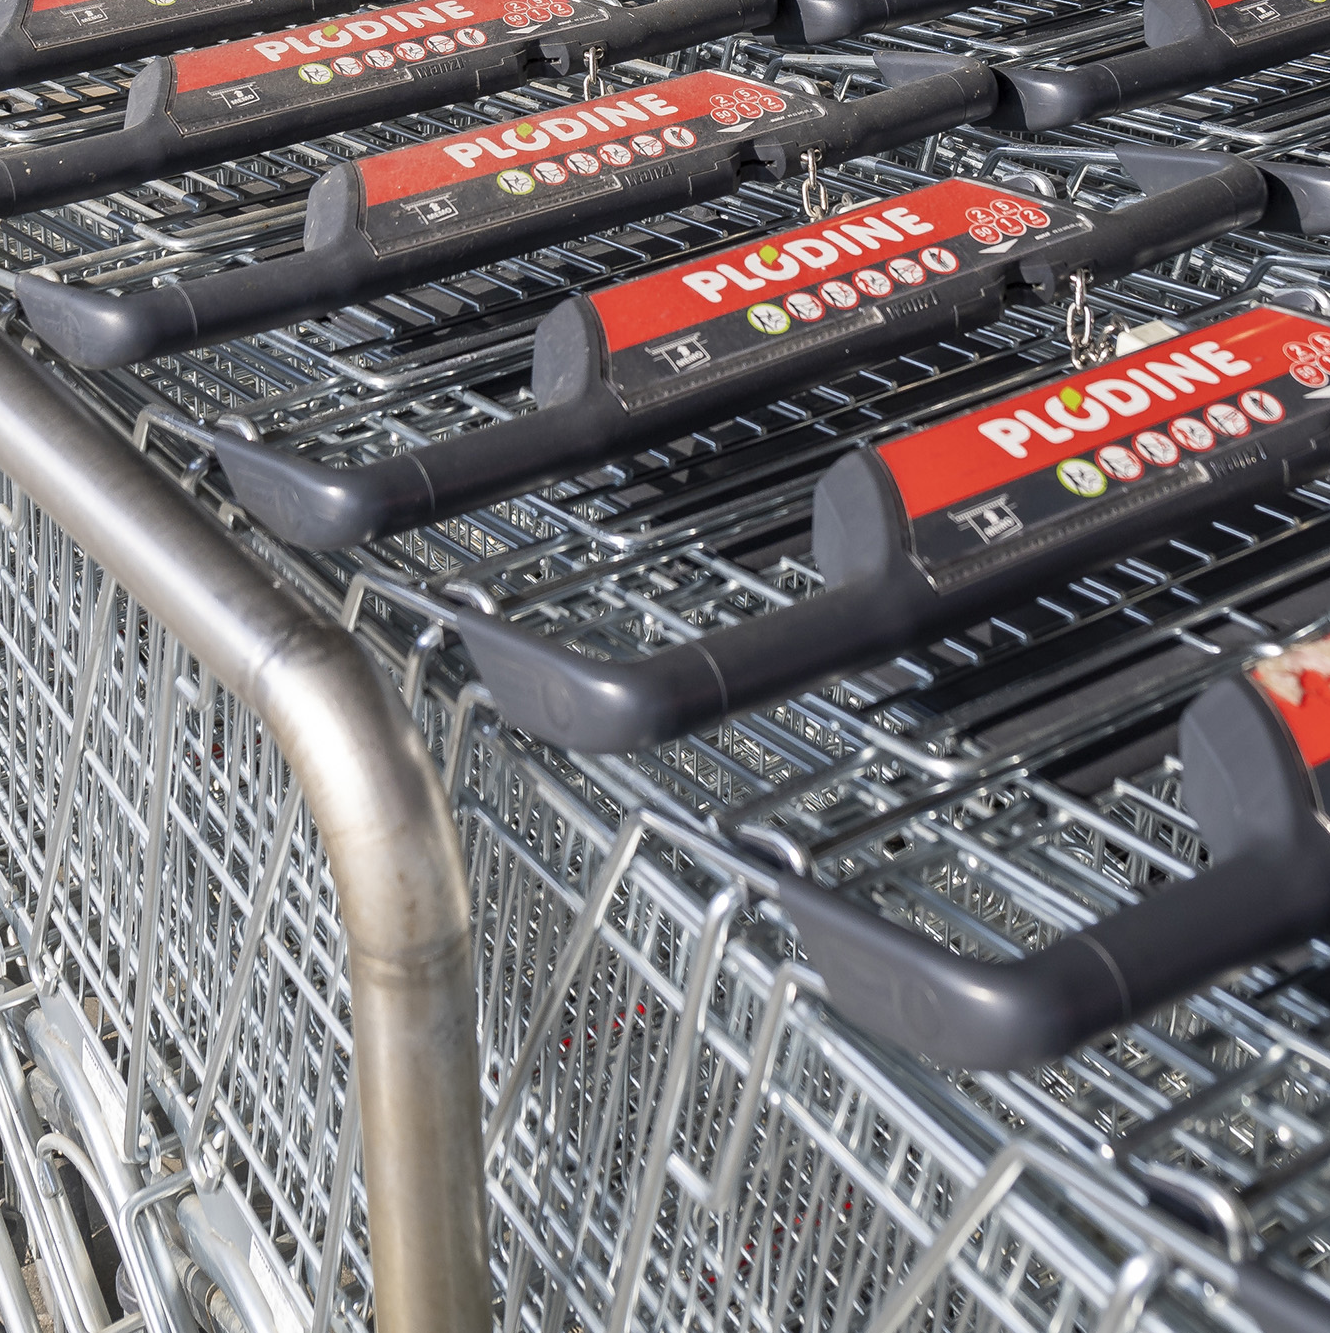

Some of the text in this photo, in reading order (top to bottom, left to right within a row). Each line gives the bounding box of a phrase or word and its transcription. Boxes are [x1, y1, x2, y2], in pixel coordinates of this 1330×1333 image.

[253, 0, 474, 62] PLODINE
[230, 95, 255, 105] MEMO
[443, 93, 678, 168] PLODINE
[427, 207, 452, 220] MEMO
[683, 207, 934, 303] PLODINE
[978, 341, 1252, 458] PLODINE
